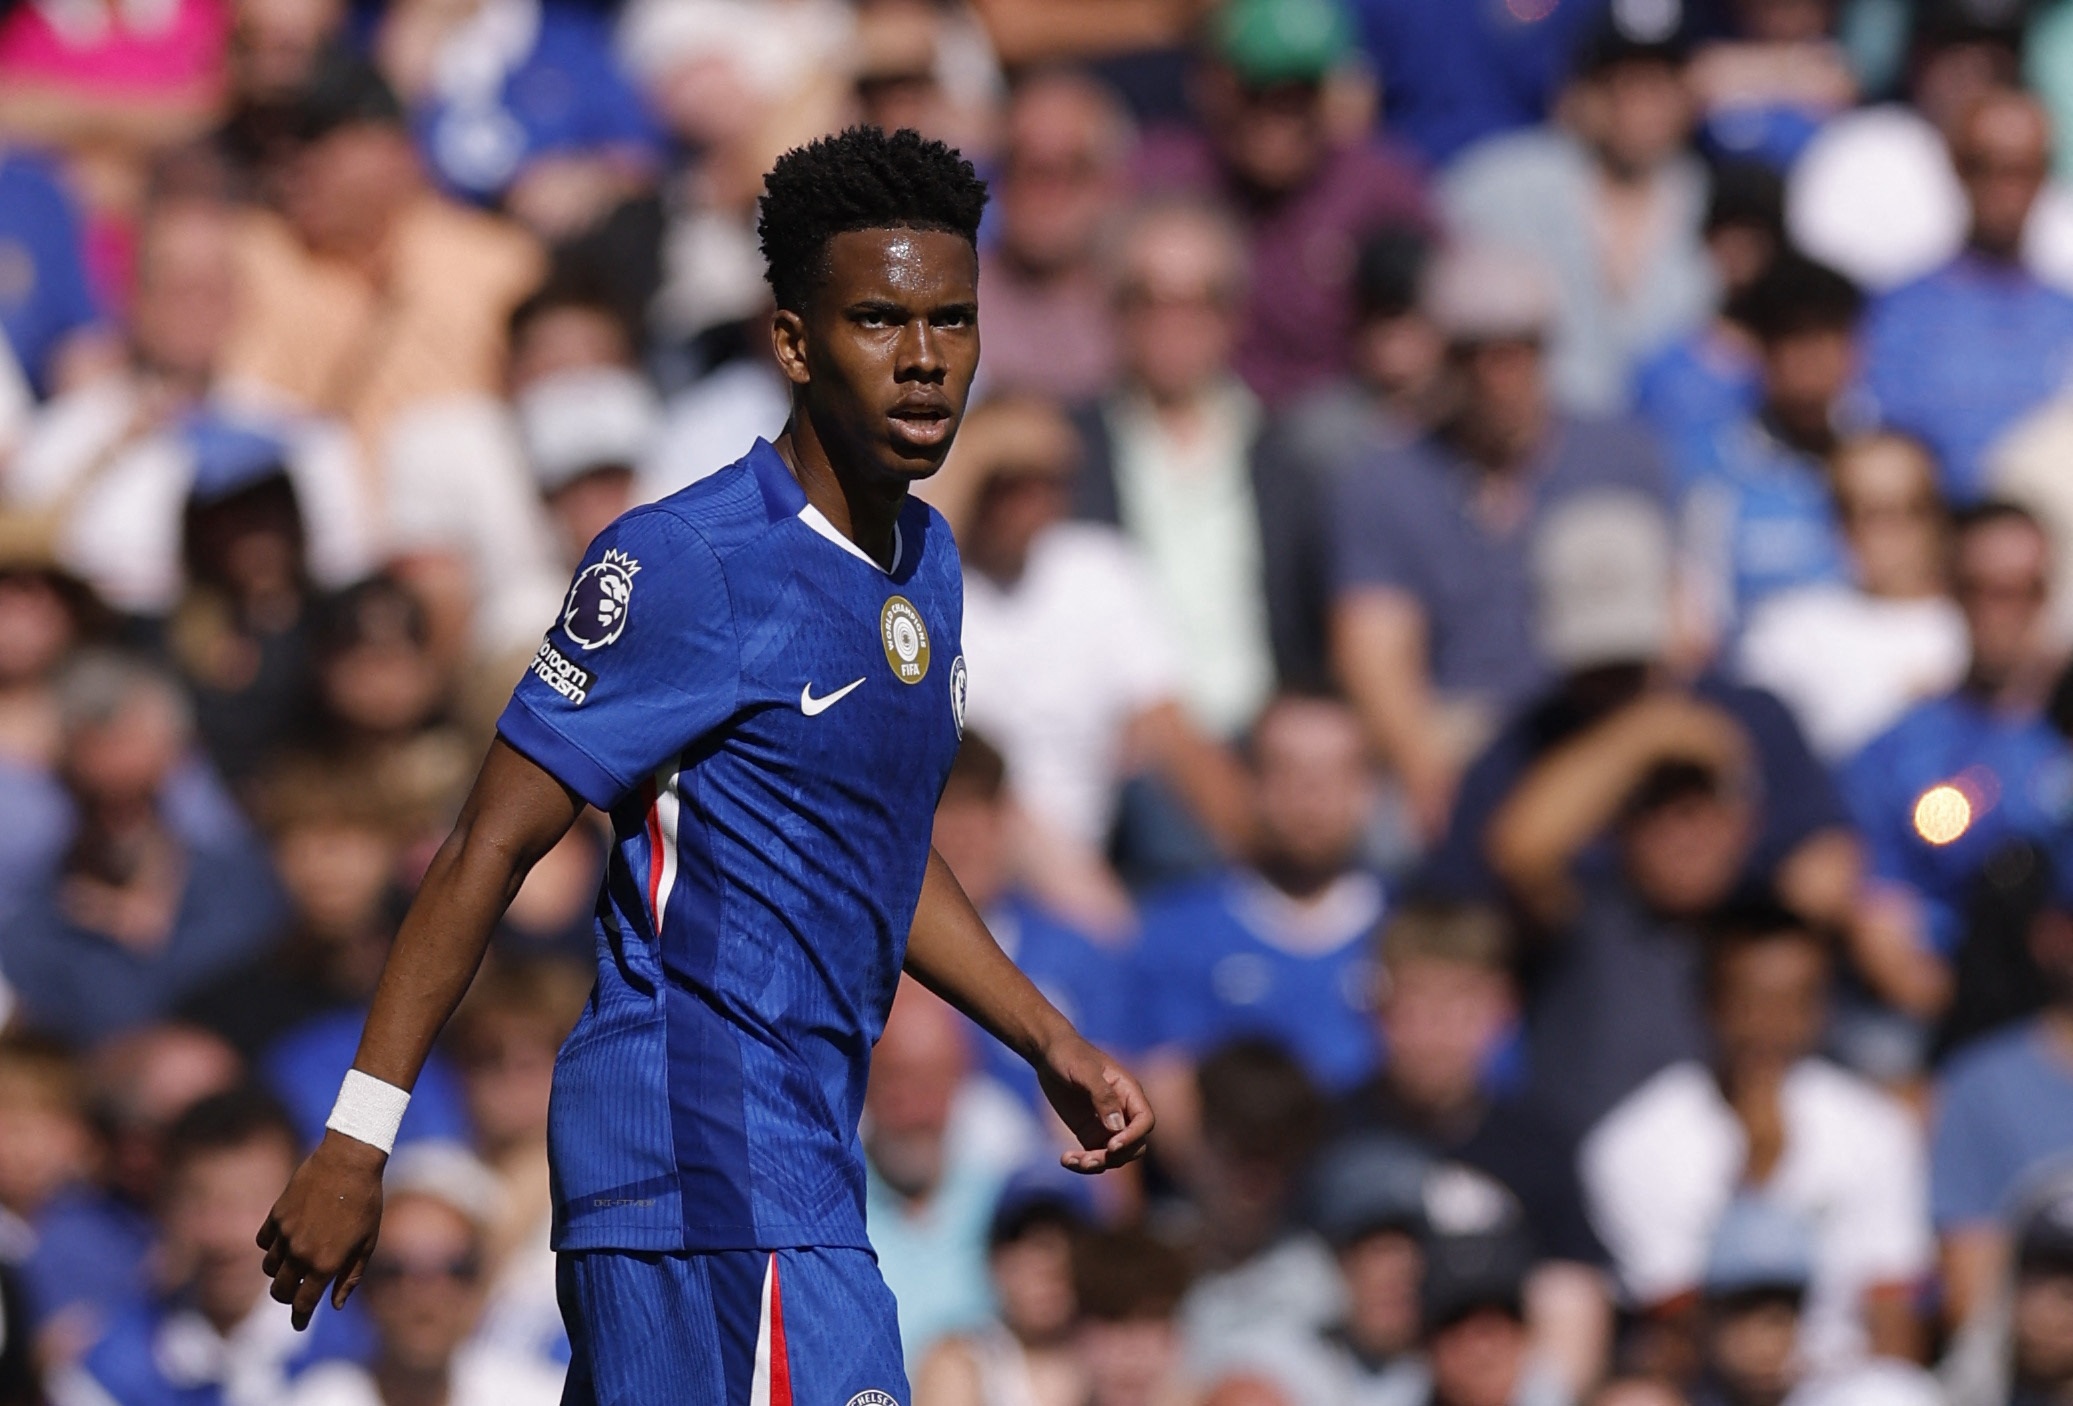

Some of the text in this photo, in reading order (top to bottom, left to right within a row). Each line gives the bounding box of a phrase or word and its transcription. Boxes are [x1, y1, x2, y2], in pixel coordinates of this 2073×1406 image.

[885, 602, 927, 651] WORLD CHAMPIONS
[534, 660, 586, 705] racism
[545, 648, 588, 688] room
[901, 663, 920, 676] FIFA
